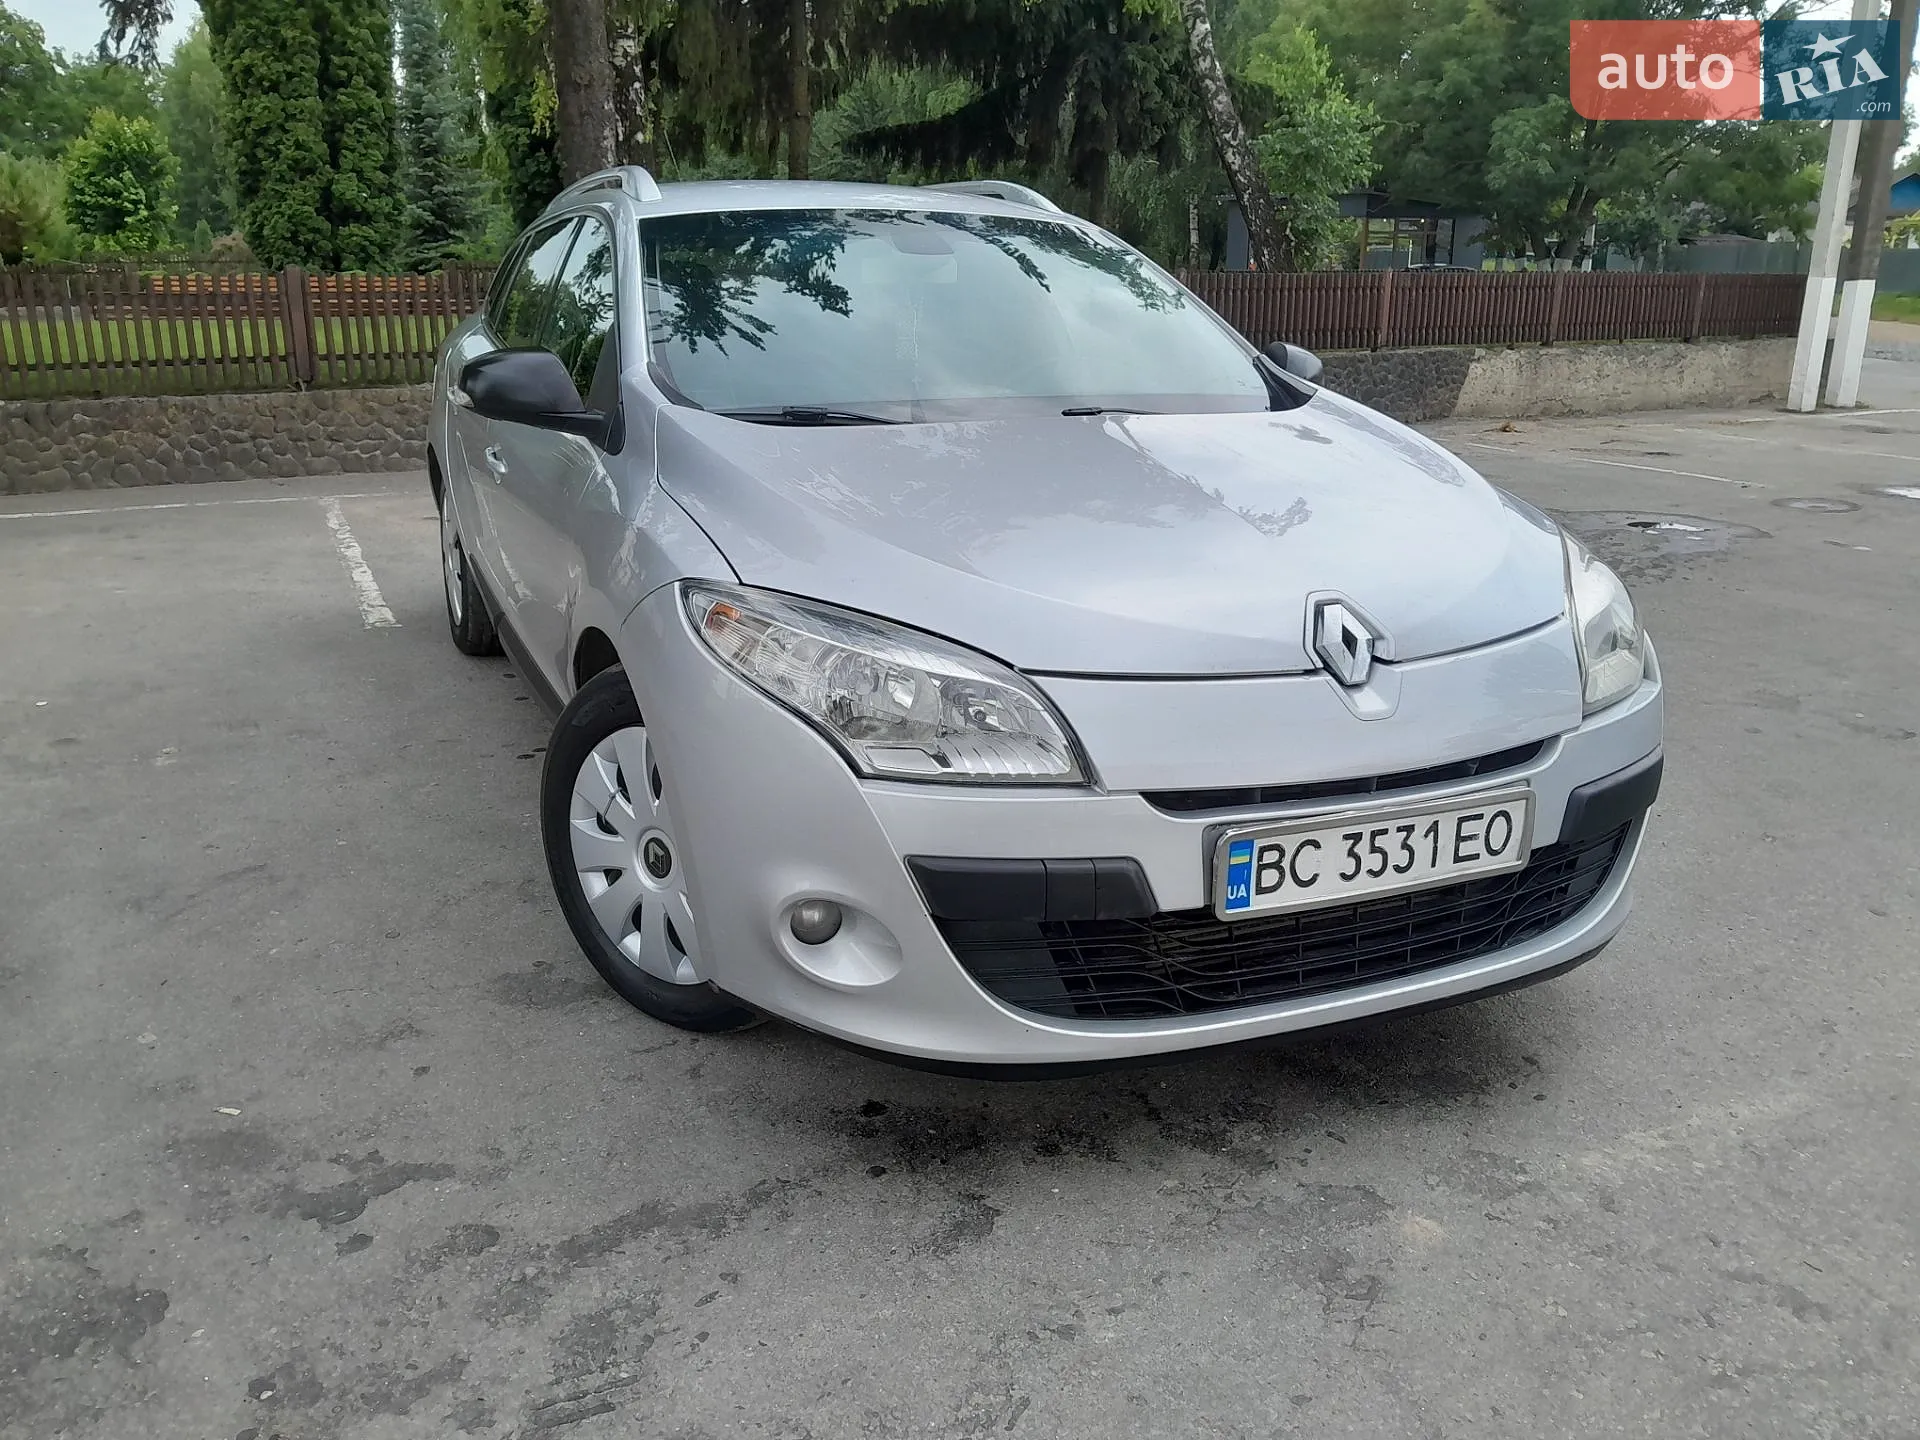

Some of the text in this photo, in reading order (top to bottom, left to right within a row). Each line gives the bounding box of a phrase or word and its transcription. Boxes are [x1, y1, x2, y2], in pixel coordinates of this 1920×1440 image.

[1255, 809, 1513, 896] BC 3531 EO
[1227, 885, 1248, 900] UA
